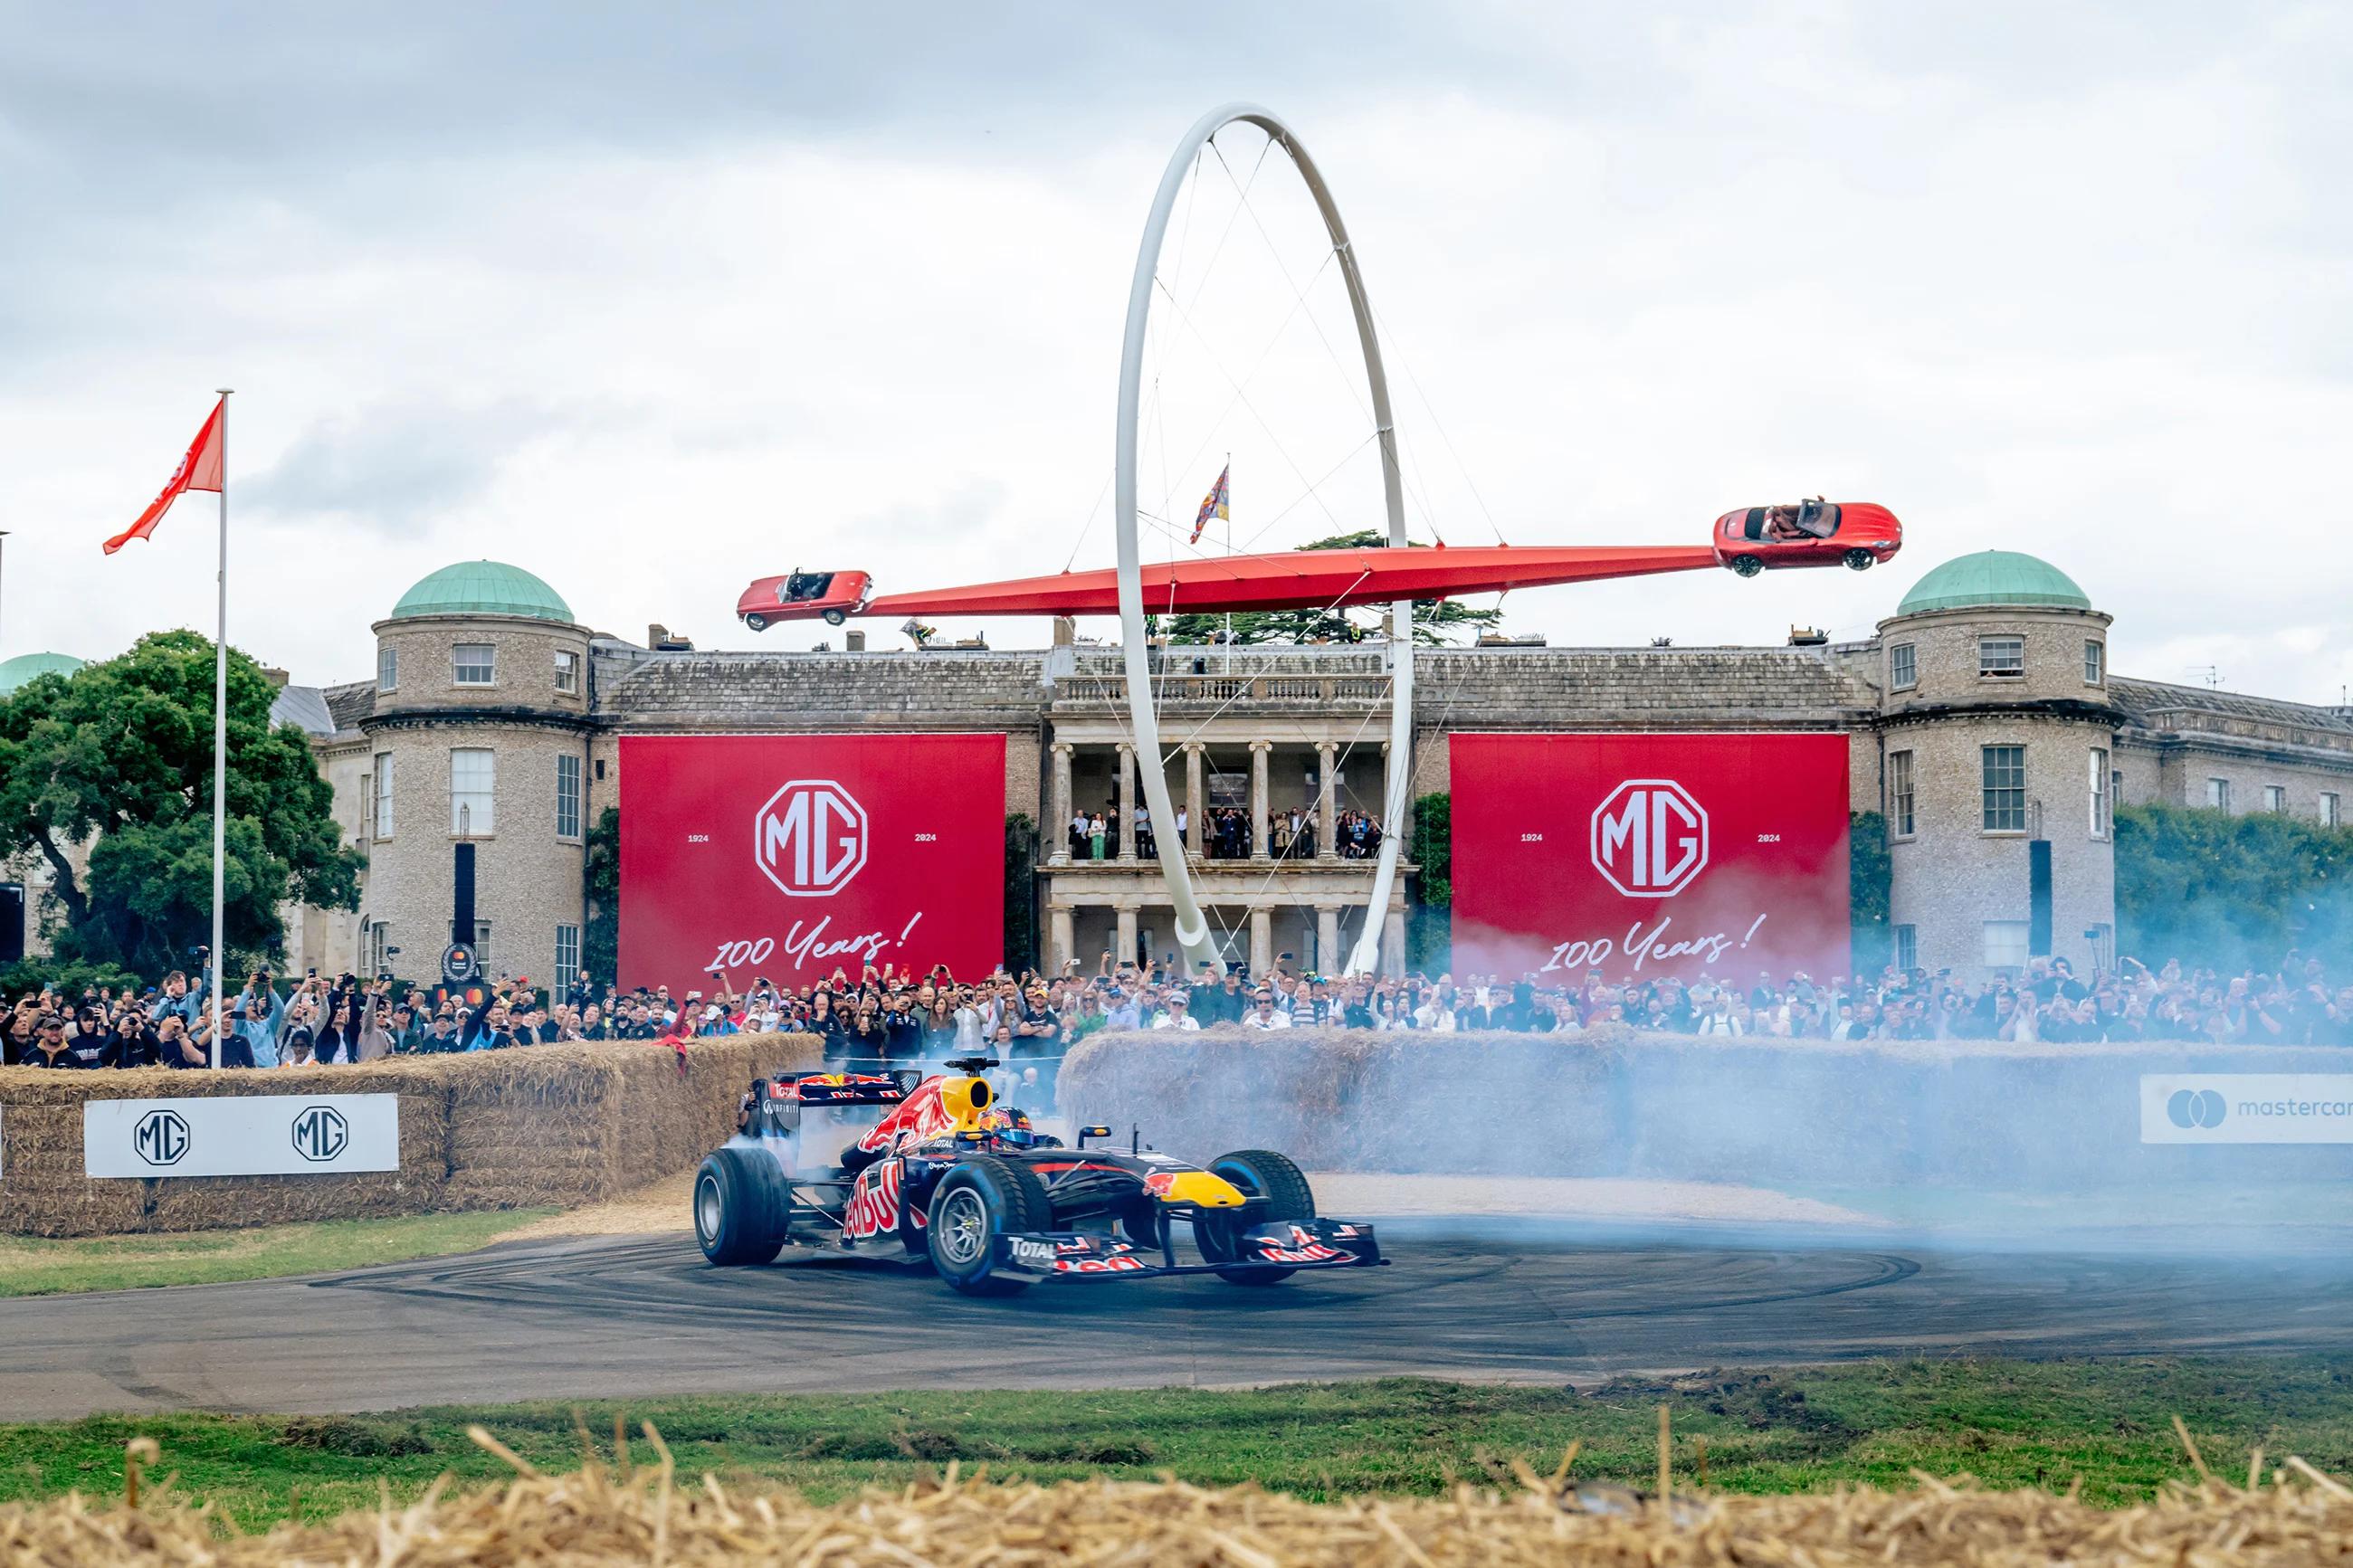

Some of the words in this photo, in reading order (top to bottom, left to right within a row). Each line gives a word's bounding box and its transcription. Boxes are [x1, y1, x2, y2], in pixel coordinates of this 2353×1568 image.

[688, 833, 709, 842] 1924
[766, 791, 857, 885] MG
[914, 833, 937, 842] 2024
[1520, 832, 1543, 842] 1924
[1602, 790, 1698, 886] MG
[1758, 833, 1780, 842] 2024
[703, 937, 775, 973] 100
[1539, 937, 1614, 973] 100
[2238, 1098, 2353, 1117] mastercar
[140, 1115, 186, 1160] MG
[298, 1111, 343, 1156] MG
[1007, 1236, 1057, 1259] TOTAL
